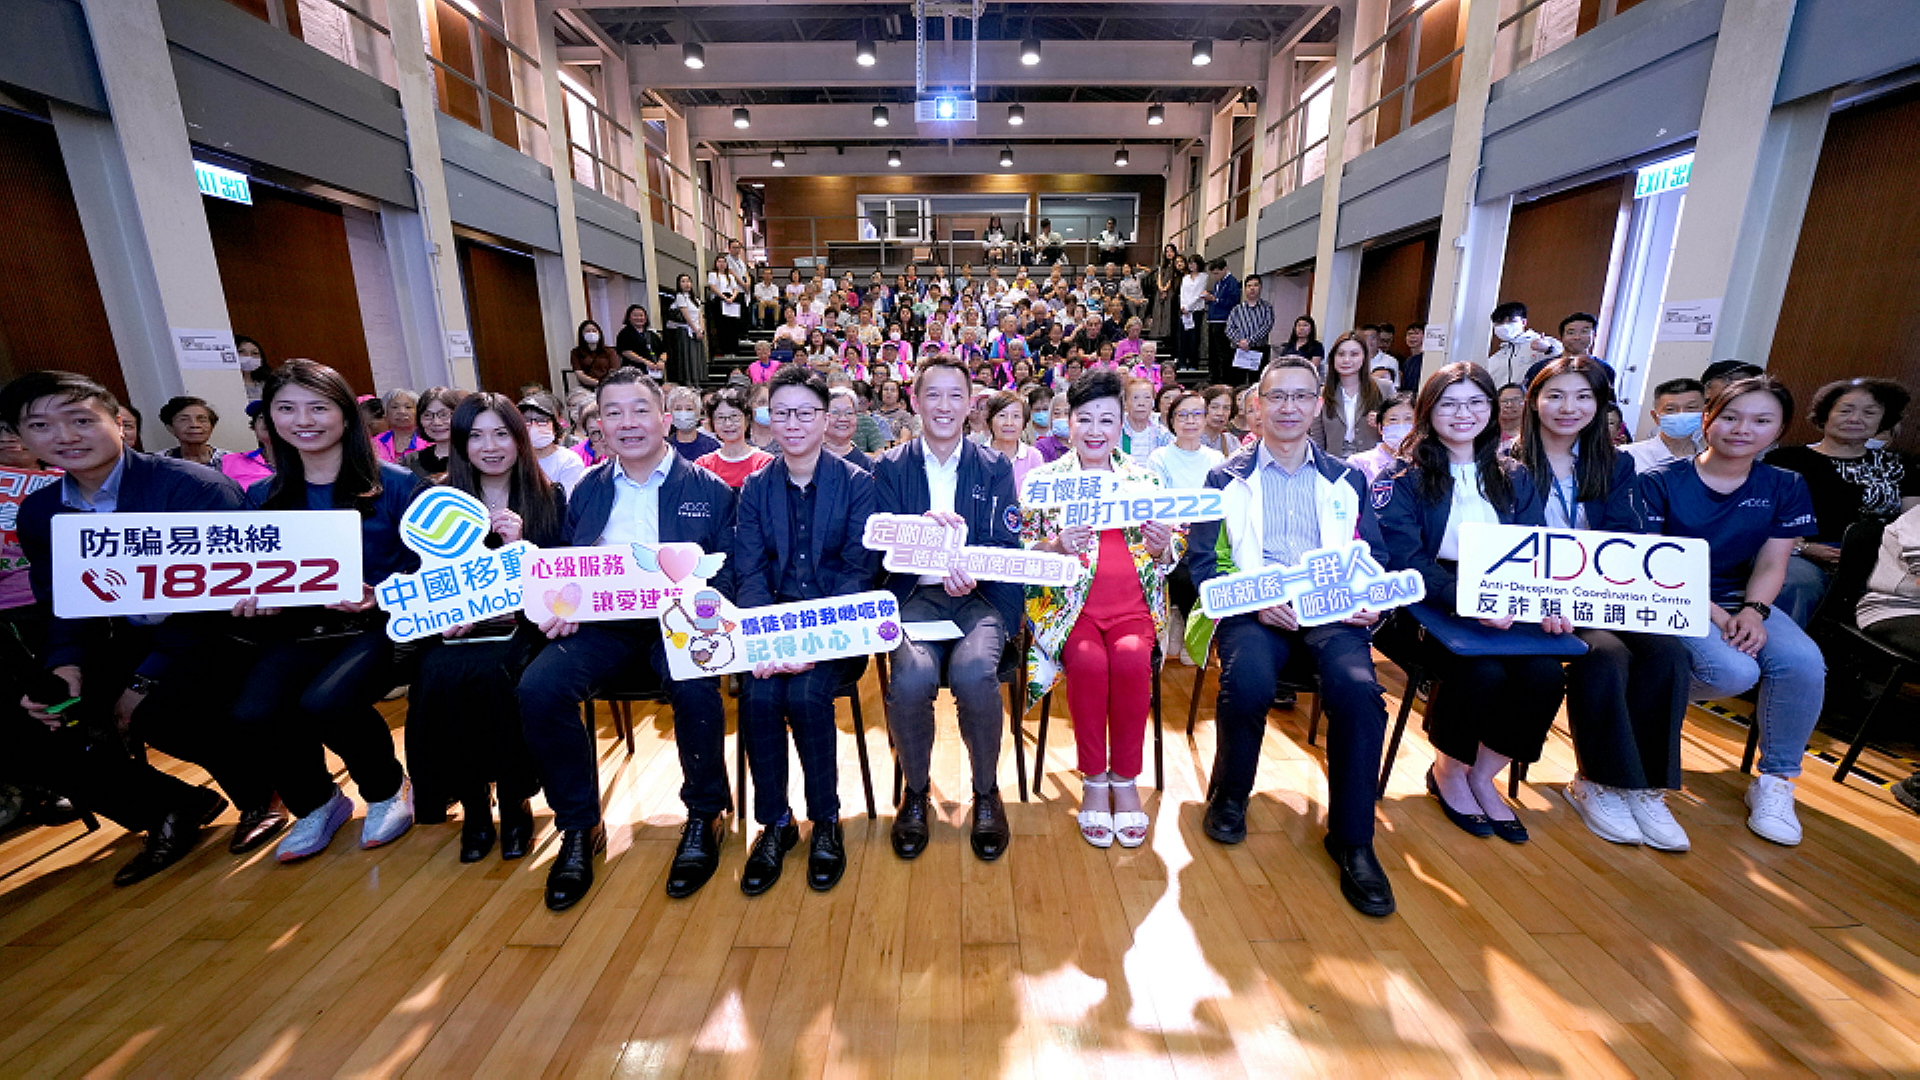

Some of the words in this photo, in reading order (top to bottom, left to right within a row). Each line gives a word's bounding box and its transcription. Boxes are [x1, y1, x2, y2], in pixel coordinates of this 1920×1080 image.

[219, 175, 250, 202] 出口
[1636, 168, 1670, 195] EXIT
[80, 525, 283, 559] 防騙易熱線
[531, 554, 625, 579] 心級服務
[1485, 531, 1686, 589] ADCC
[135, 556, 340, 599] 18222
[1479, 579, 1569, 596] Anti-Deception
[1572, 586, 1648, 601] Coordination
[1652, 593, 1691, 606] Centre
[391, 608, 464, 638] China
[1477, 592, 1689, 630] 反詐騙協調中心
